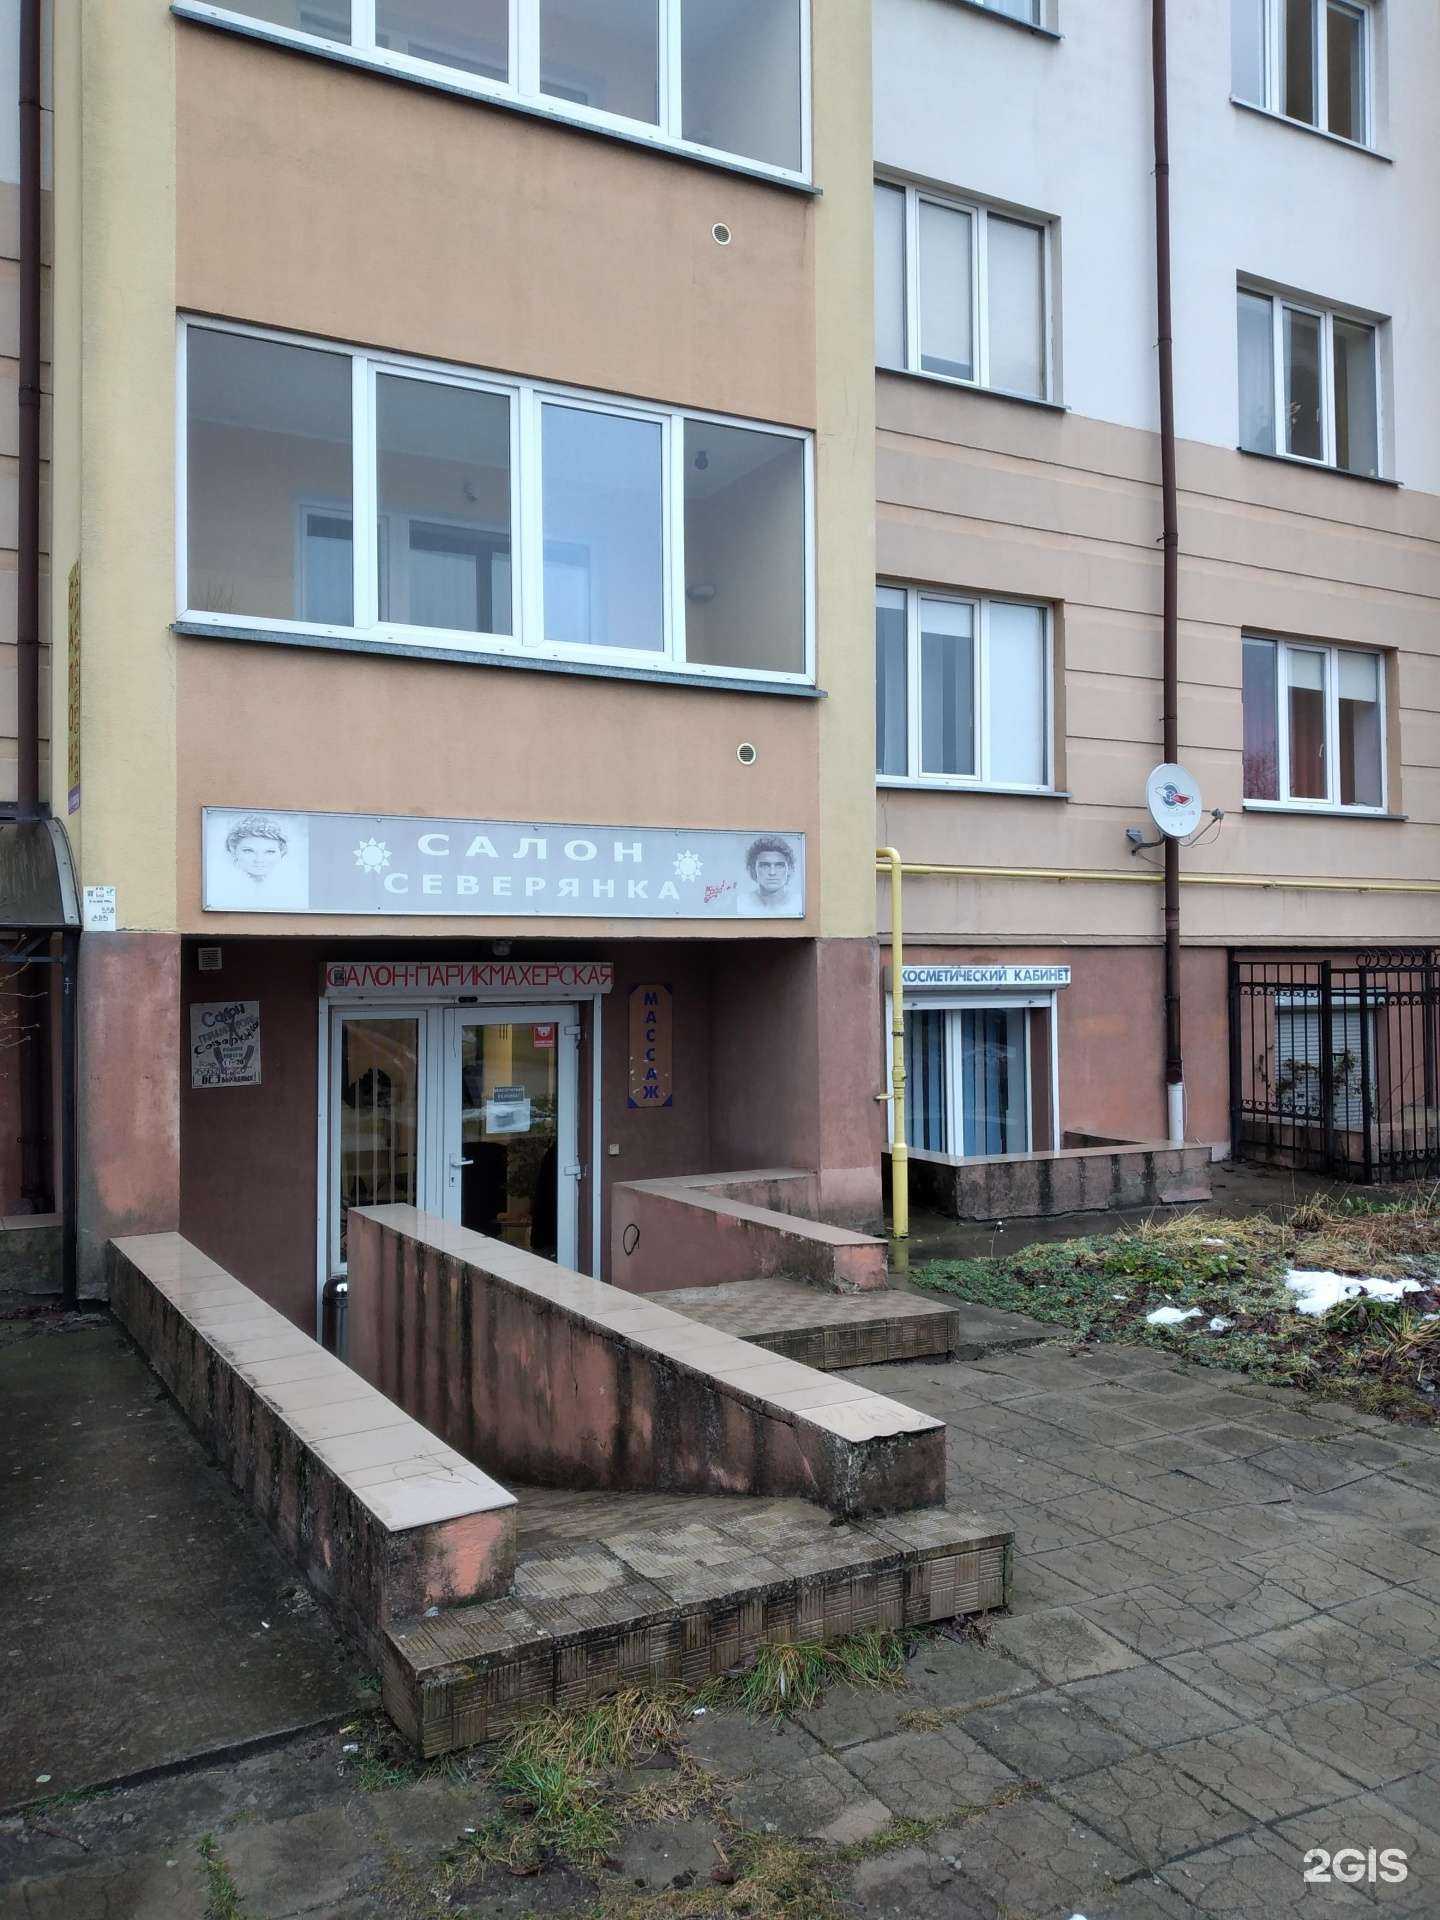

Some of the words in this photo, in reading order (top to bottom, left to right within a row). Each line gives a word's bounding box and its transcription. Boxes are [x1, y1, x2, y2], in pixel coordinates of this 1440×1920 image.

[417, 834, 644, 861] САЛОН
[383, 872, 681, 900] СЕВЕРЯНКА
[326, 964, 614, 987] САЛОН-ПАРИКМАХЕРСКАЯ
[1014, 967, 1069, 982] КАБИНЕТ
[643, 991, 660, 1100] МАССАЖ
